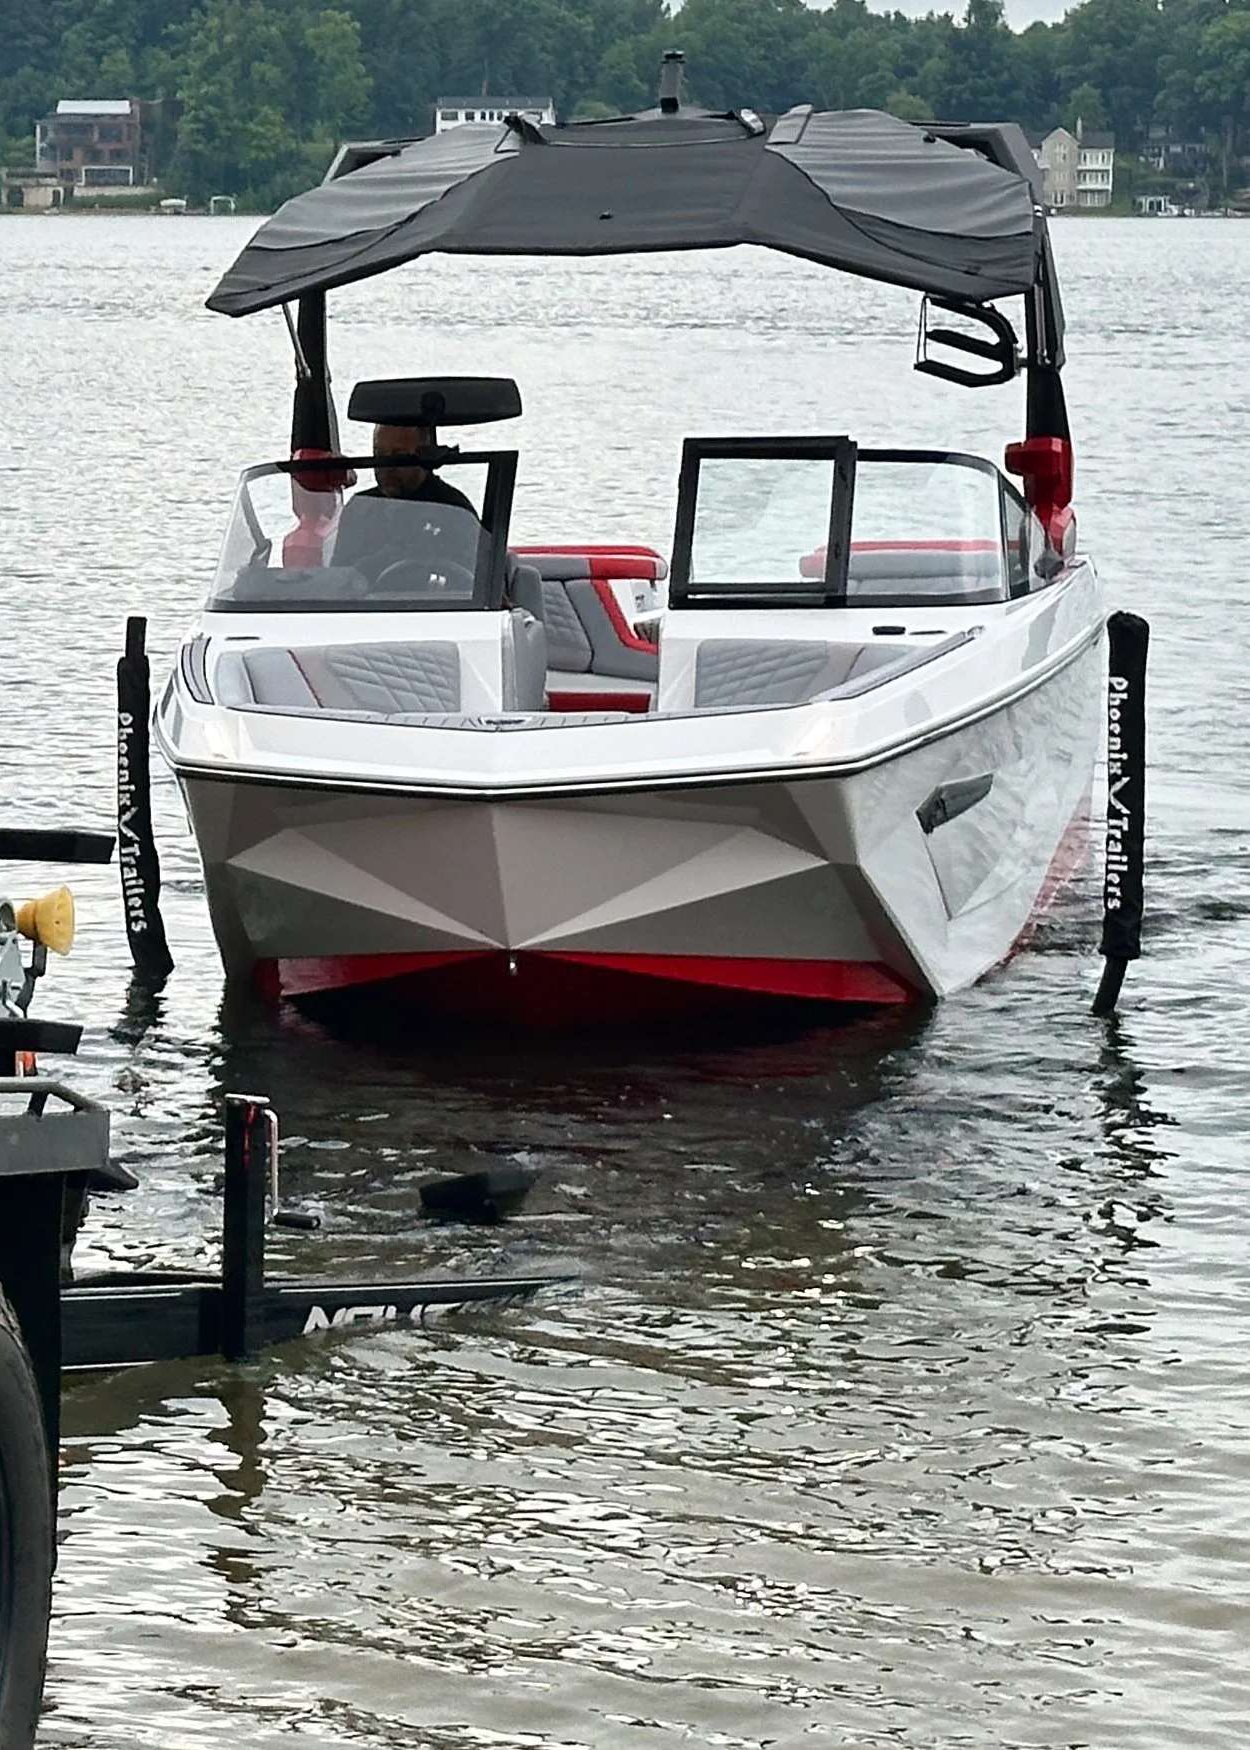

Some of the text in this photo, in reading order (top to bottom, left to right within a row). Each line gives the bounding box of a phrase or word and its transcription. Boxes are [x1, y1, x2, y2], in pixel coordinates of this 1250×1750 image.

[118, 712, 148, 932] Phoenix Trailers
[1107, 676, 1129, 909] Phoenix Trailers
